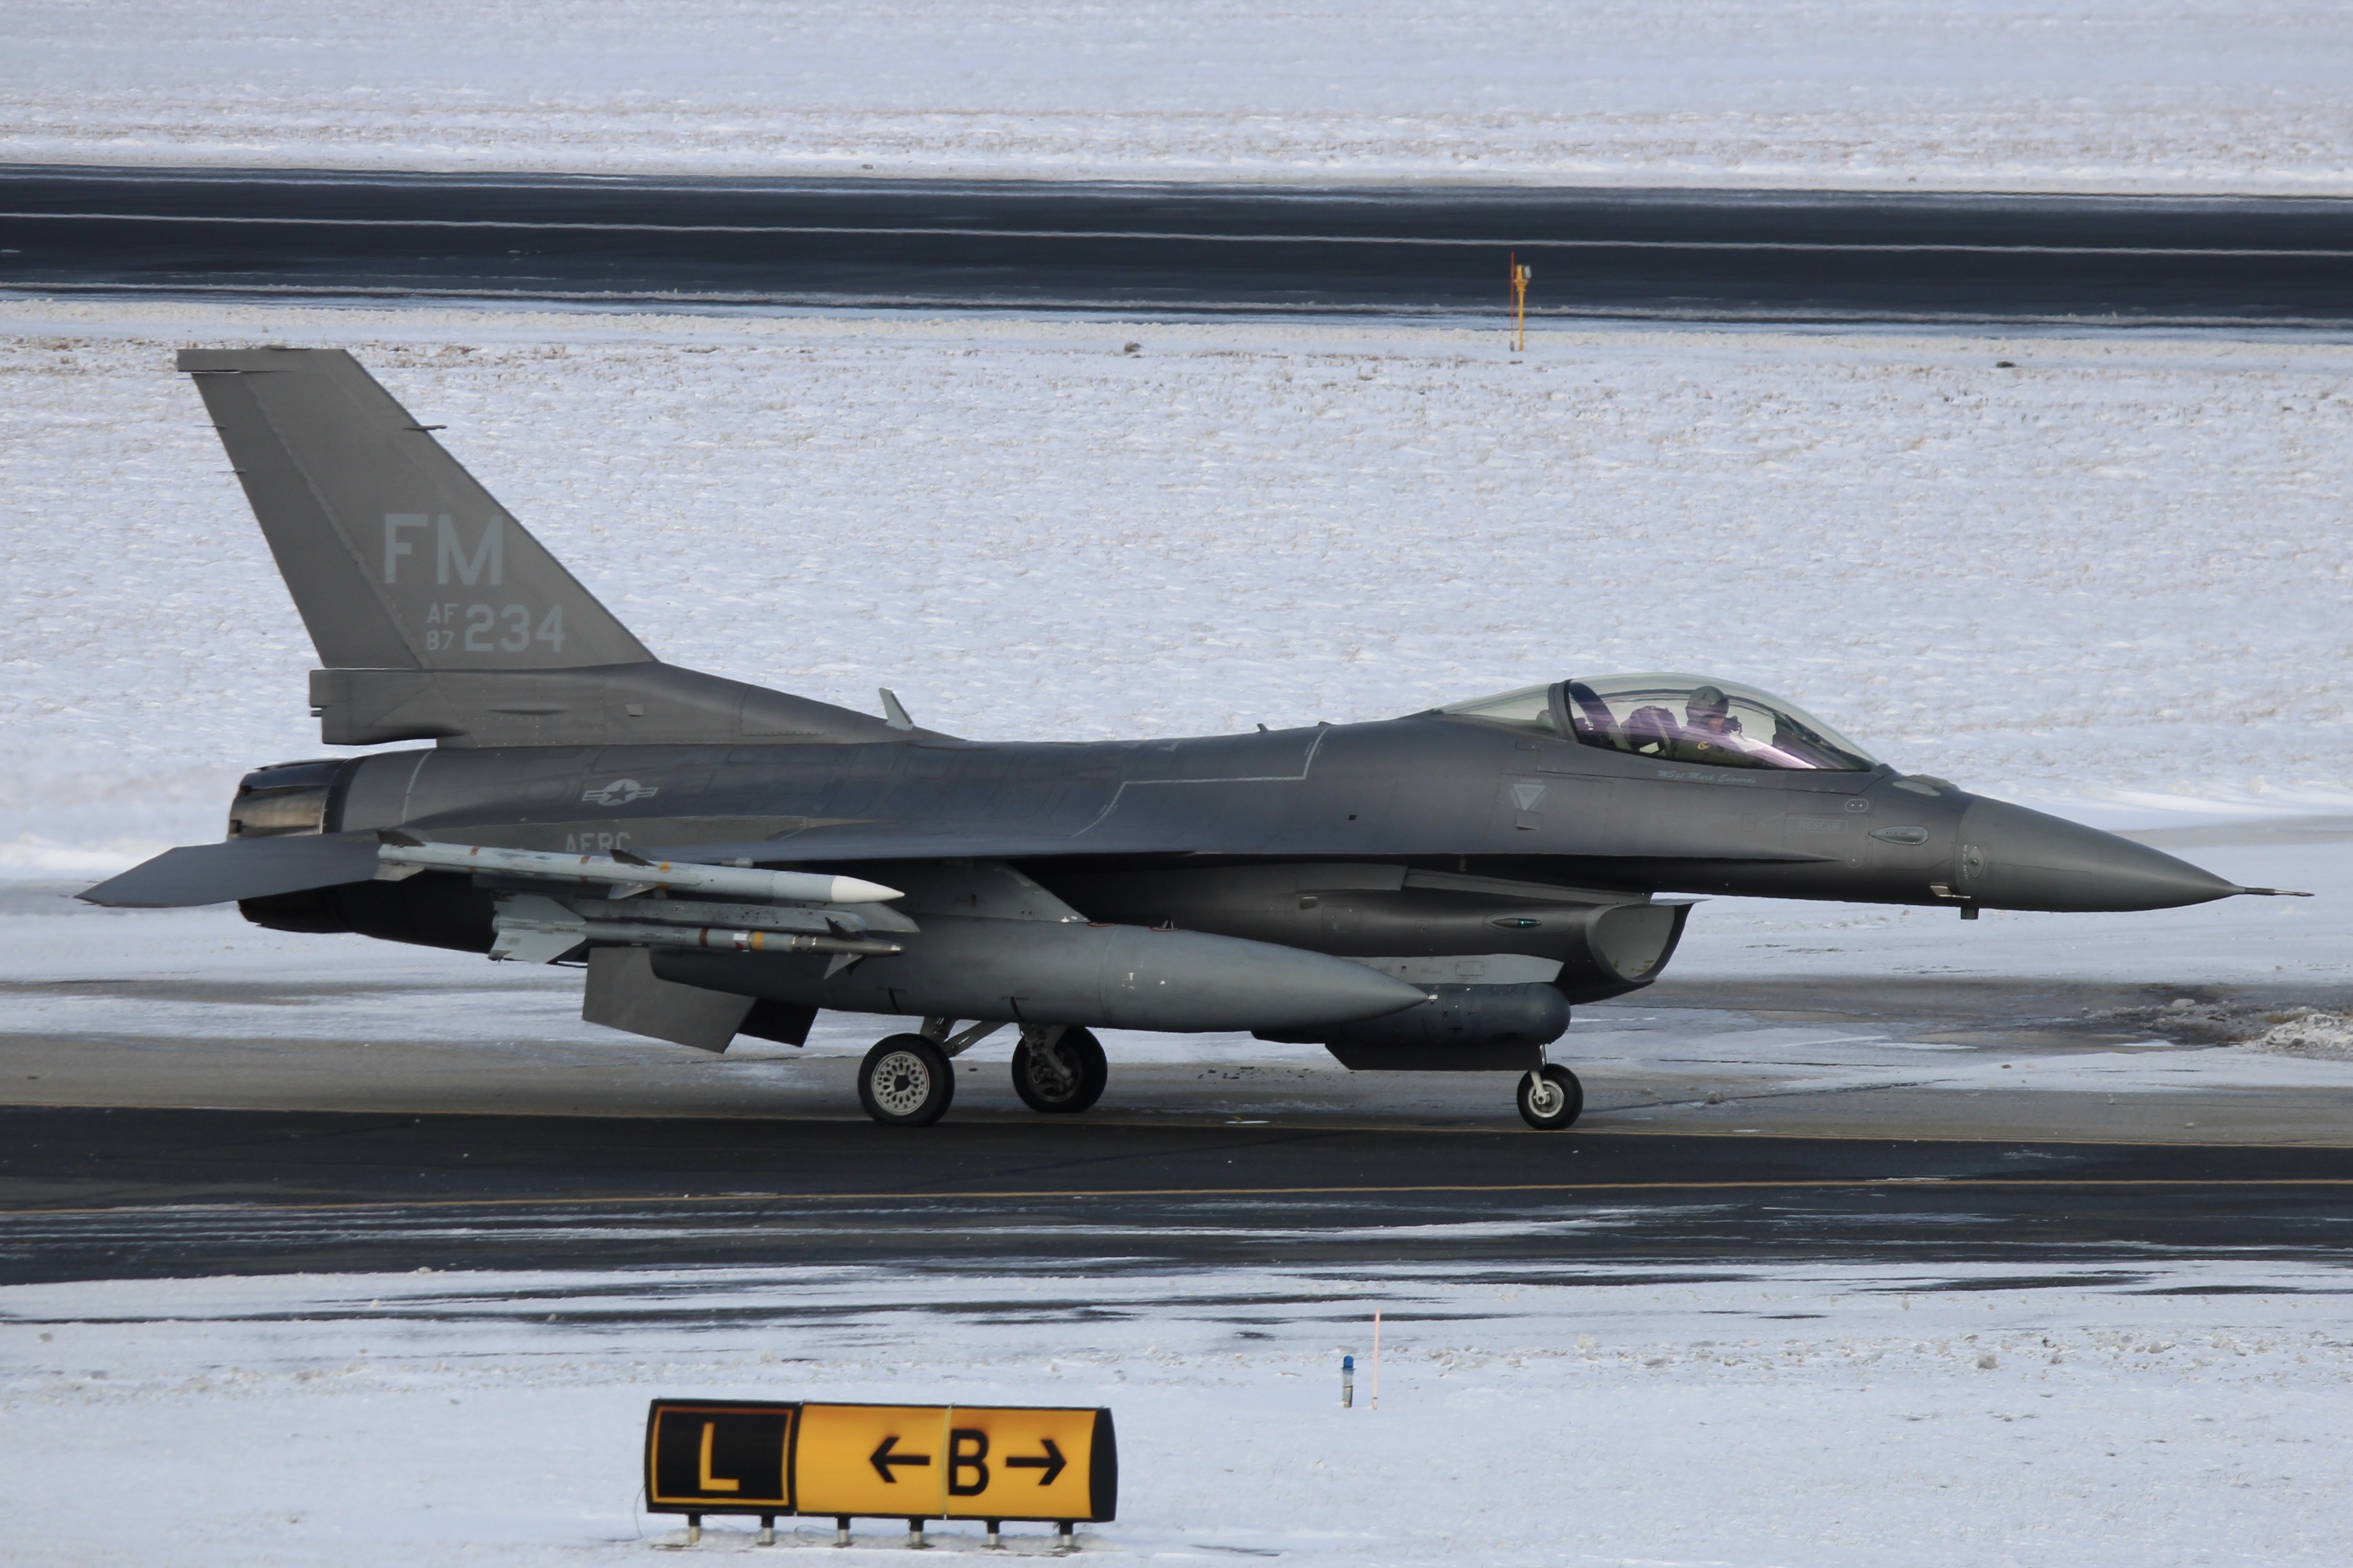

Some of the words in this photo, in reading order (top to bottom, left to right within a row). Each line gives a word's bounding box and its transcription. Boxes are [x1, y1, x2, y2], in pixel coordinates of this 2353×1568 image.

[383, 513, 505, 586] FM
[426, 603, 459, 624] AF
[464, 604, 566, 652] 234
[426, 629, 454, 651] 87
[1798, 820, 1842, 831] RESCUE
[699, 1422, 739, 1492] L
[948, 1428, 989, 1496] B
